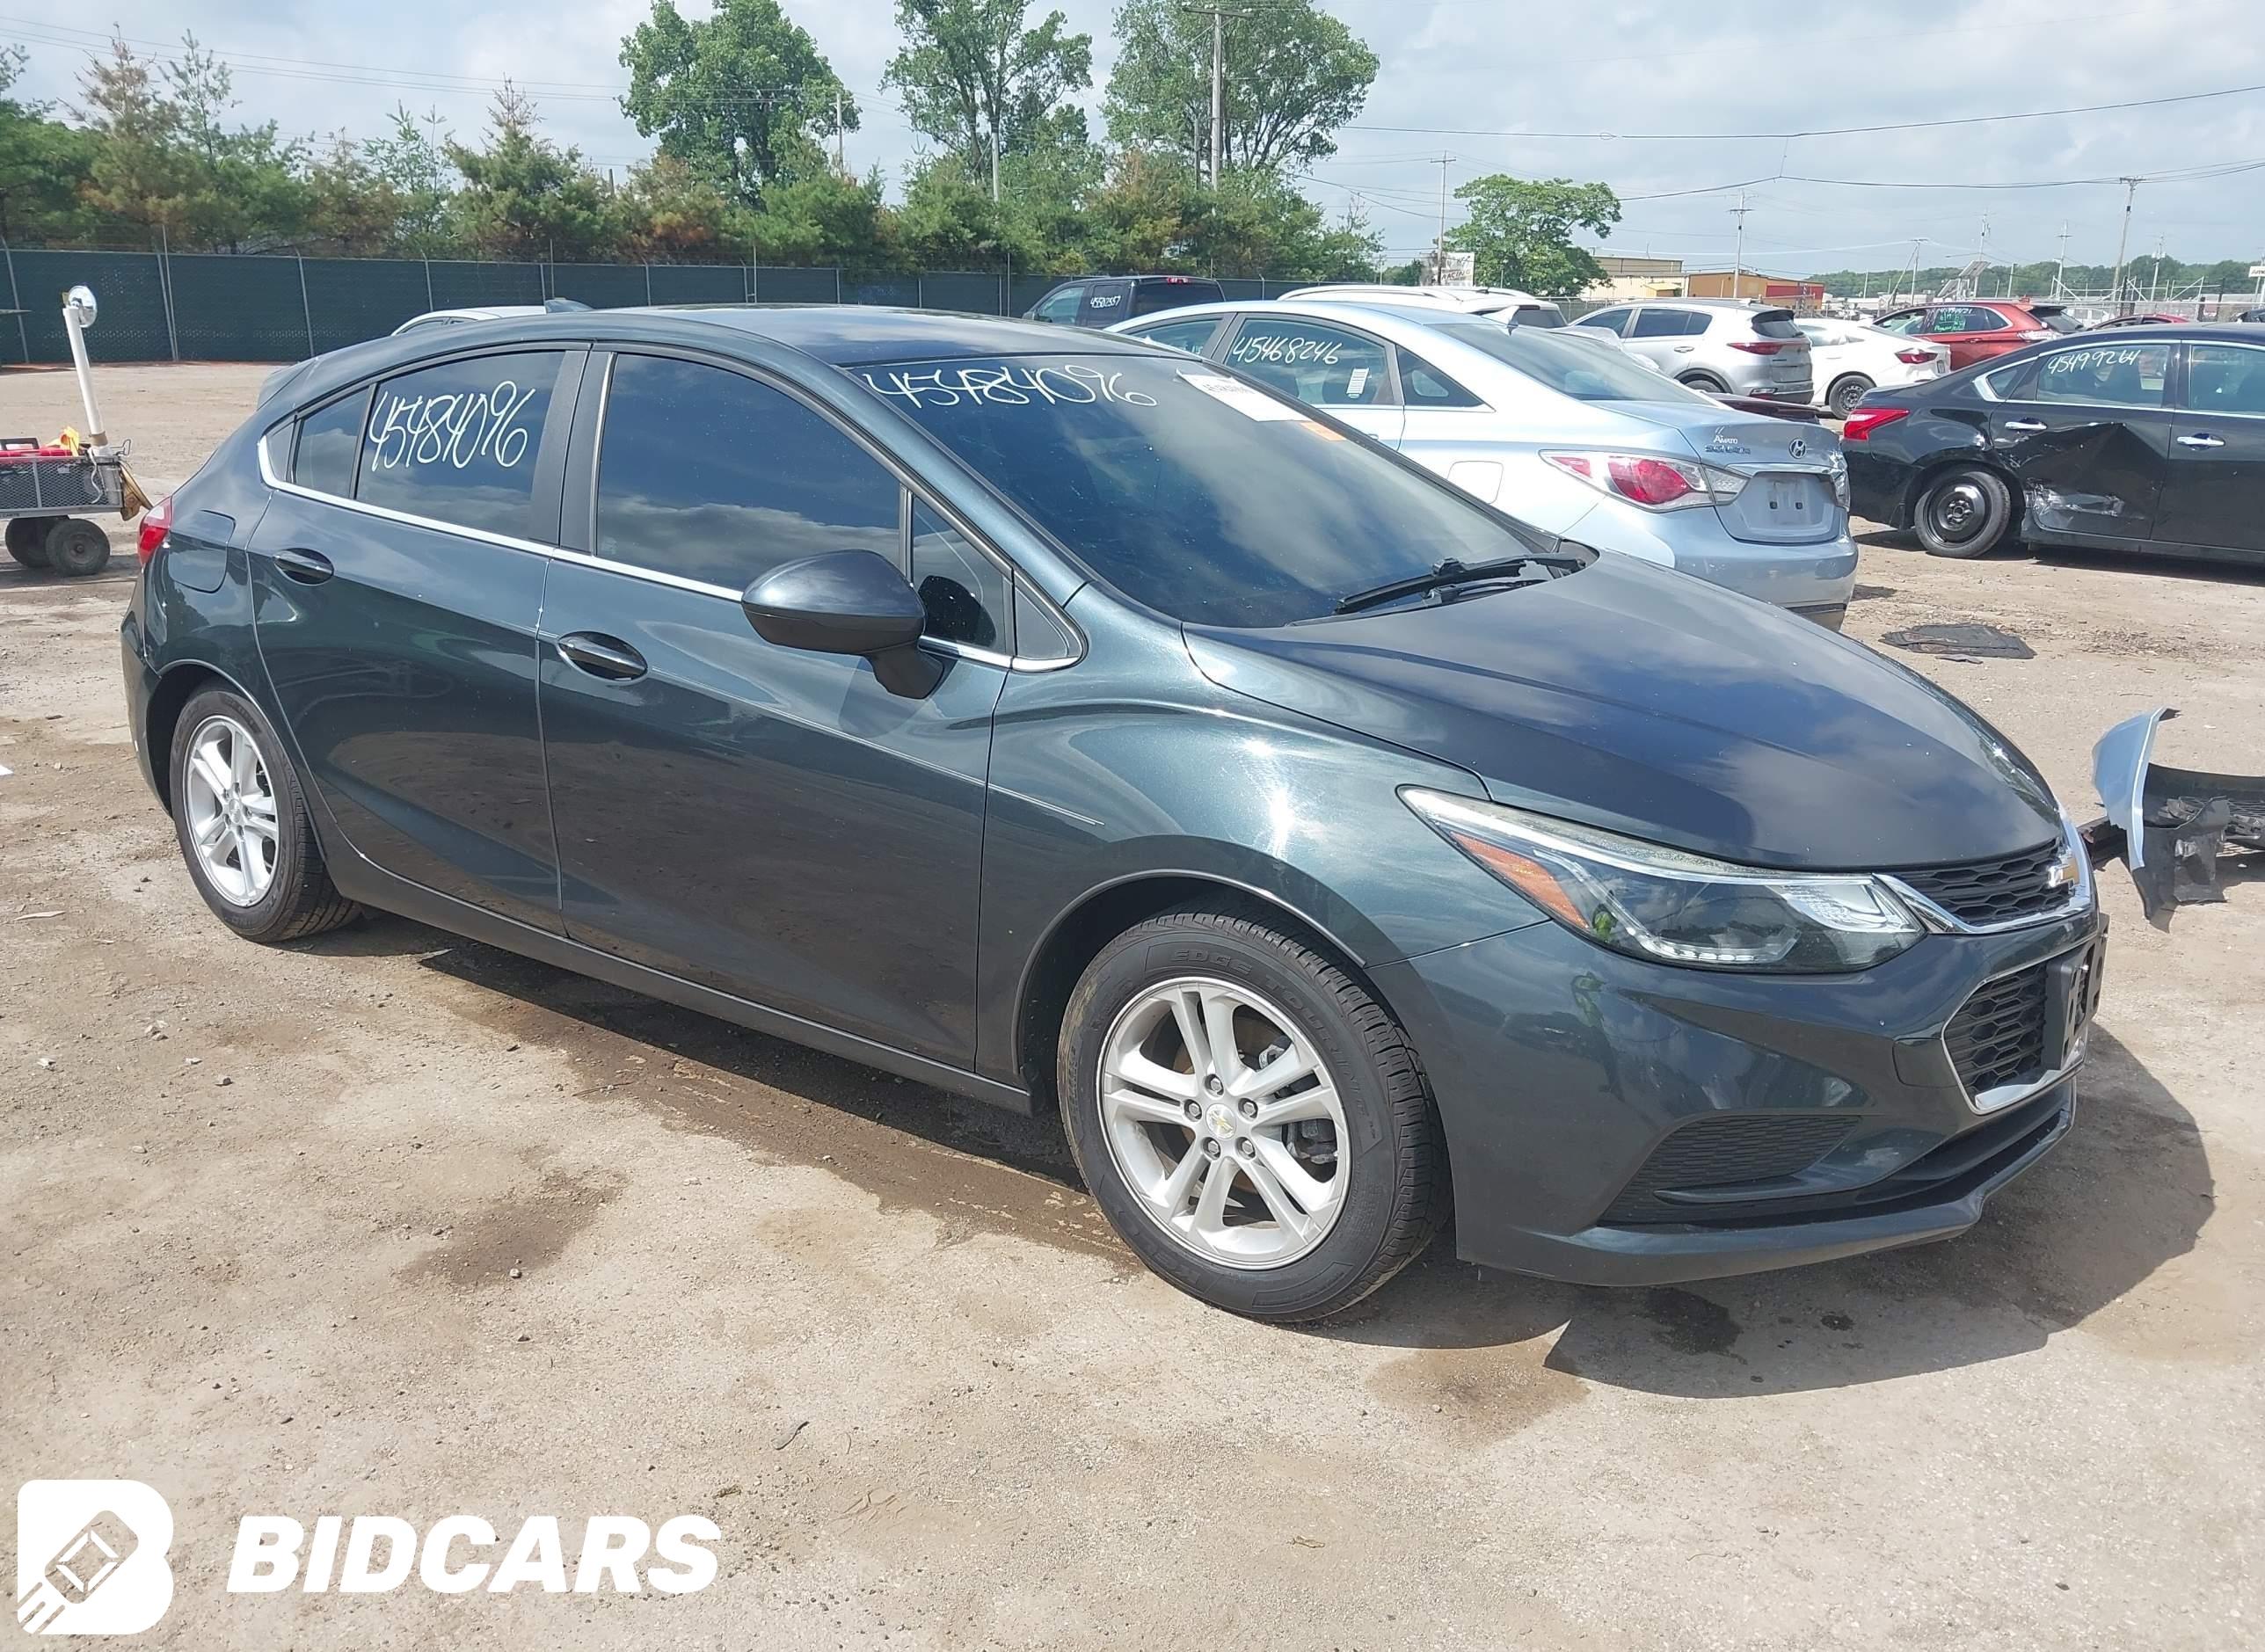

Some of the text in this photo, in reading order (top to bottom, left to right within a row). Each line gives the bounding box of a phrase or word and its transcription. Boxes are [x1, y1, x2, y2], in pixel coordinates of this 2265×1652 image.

[1233, 336, 1343, 365] 45468246
[2048, 349, 2142, 375] 45499264
[863, 365, 1157, 409] 45484096
[368, 380, 536, 472] 45484096
[1170, 950, 1252, 974] EDGE
